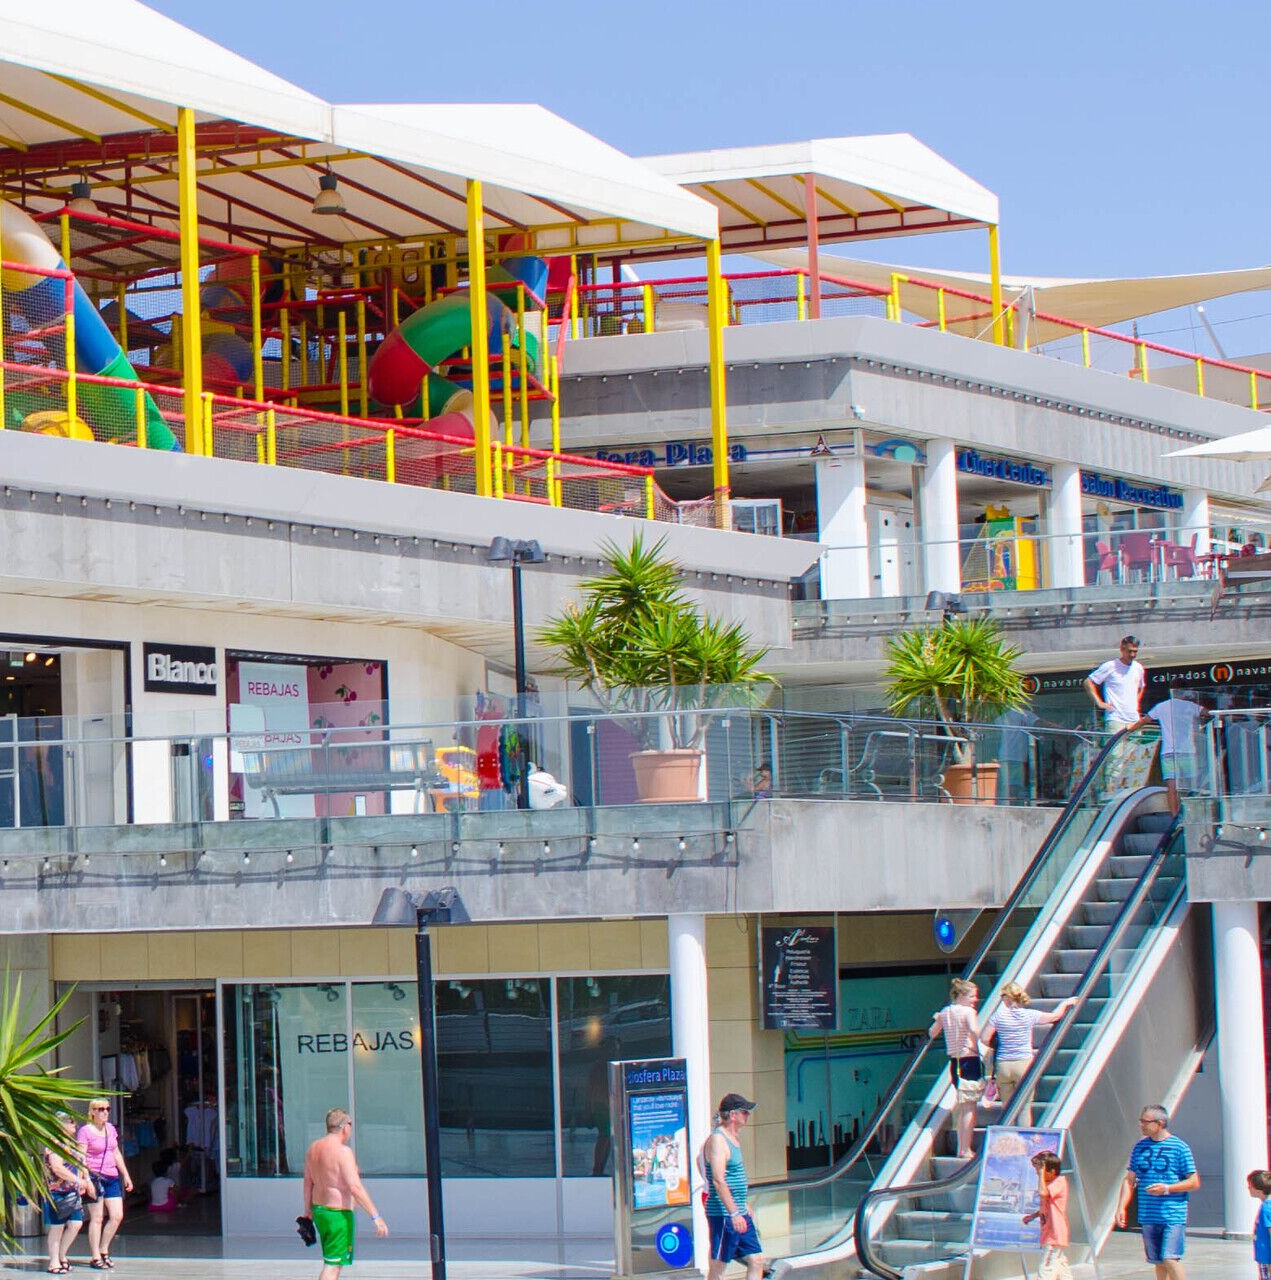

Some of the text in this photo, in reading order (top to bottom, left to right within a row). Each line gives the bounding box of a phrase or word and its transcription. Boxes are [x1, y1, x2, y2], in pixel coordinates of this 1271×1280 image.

[665, 440, 746, 466] Plaa
[147, 652, 217, 686] Blanco
[1152, 669, 1207, 684] calzados
[247, 681, 299, 698] REBAJAS
[1043, 677, 1084, 689] navarr
[297, 1030, 414, 1054] REBAJAS
[662, 1067, 685, 1082] Plaza
[1137, 1146, 1171, 1173] 35
